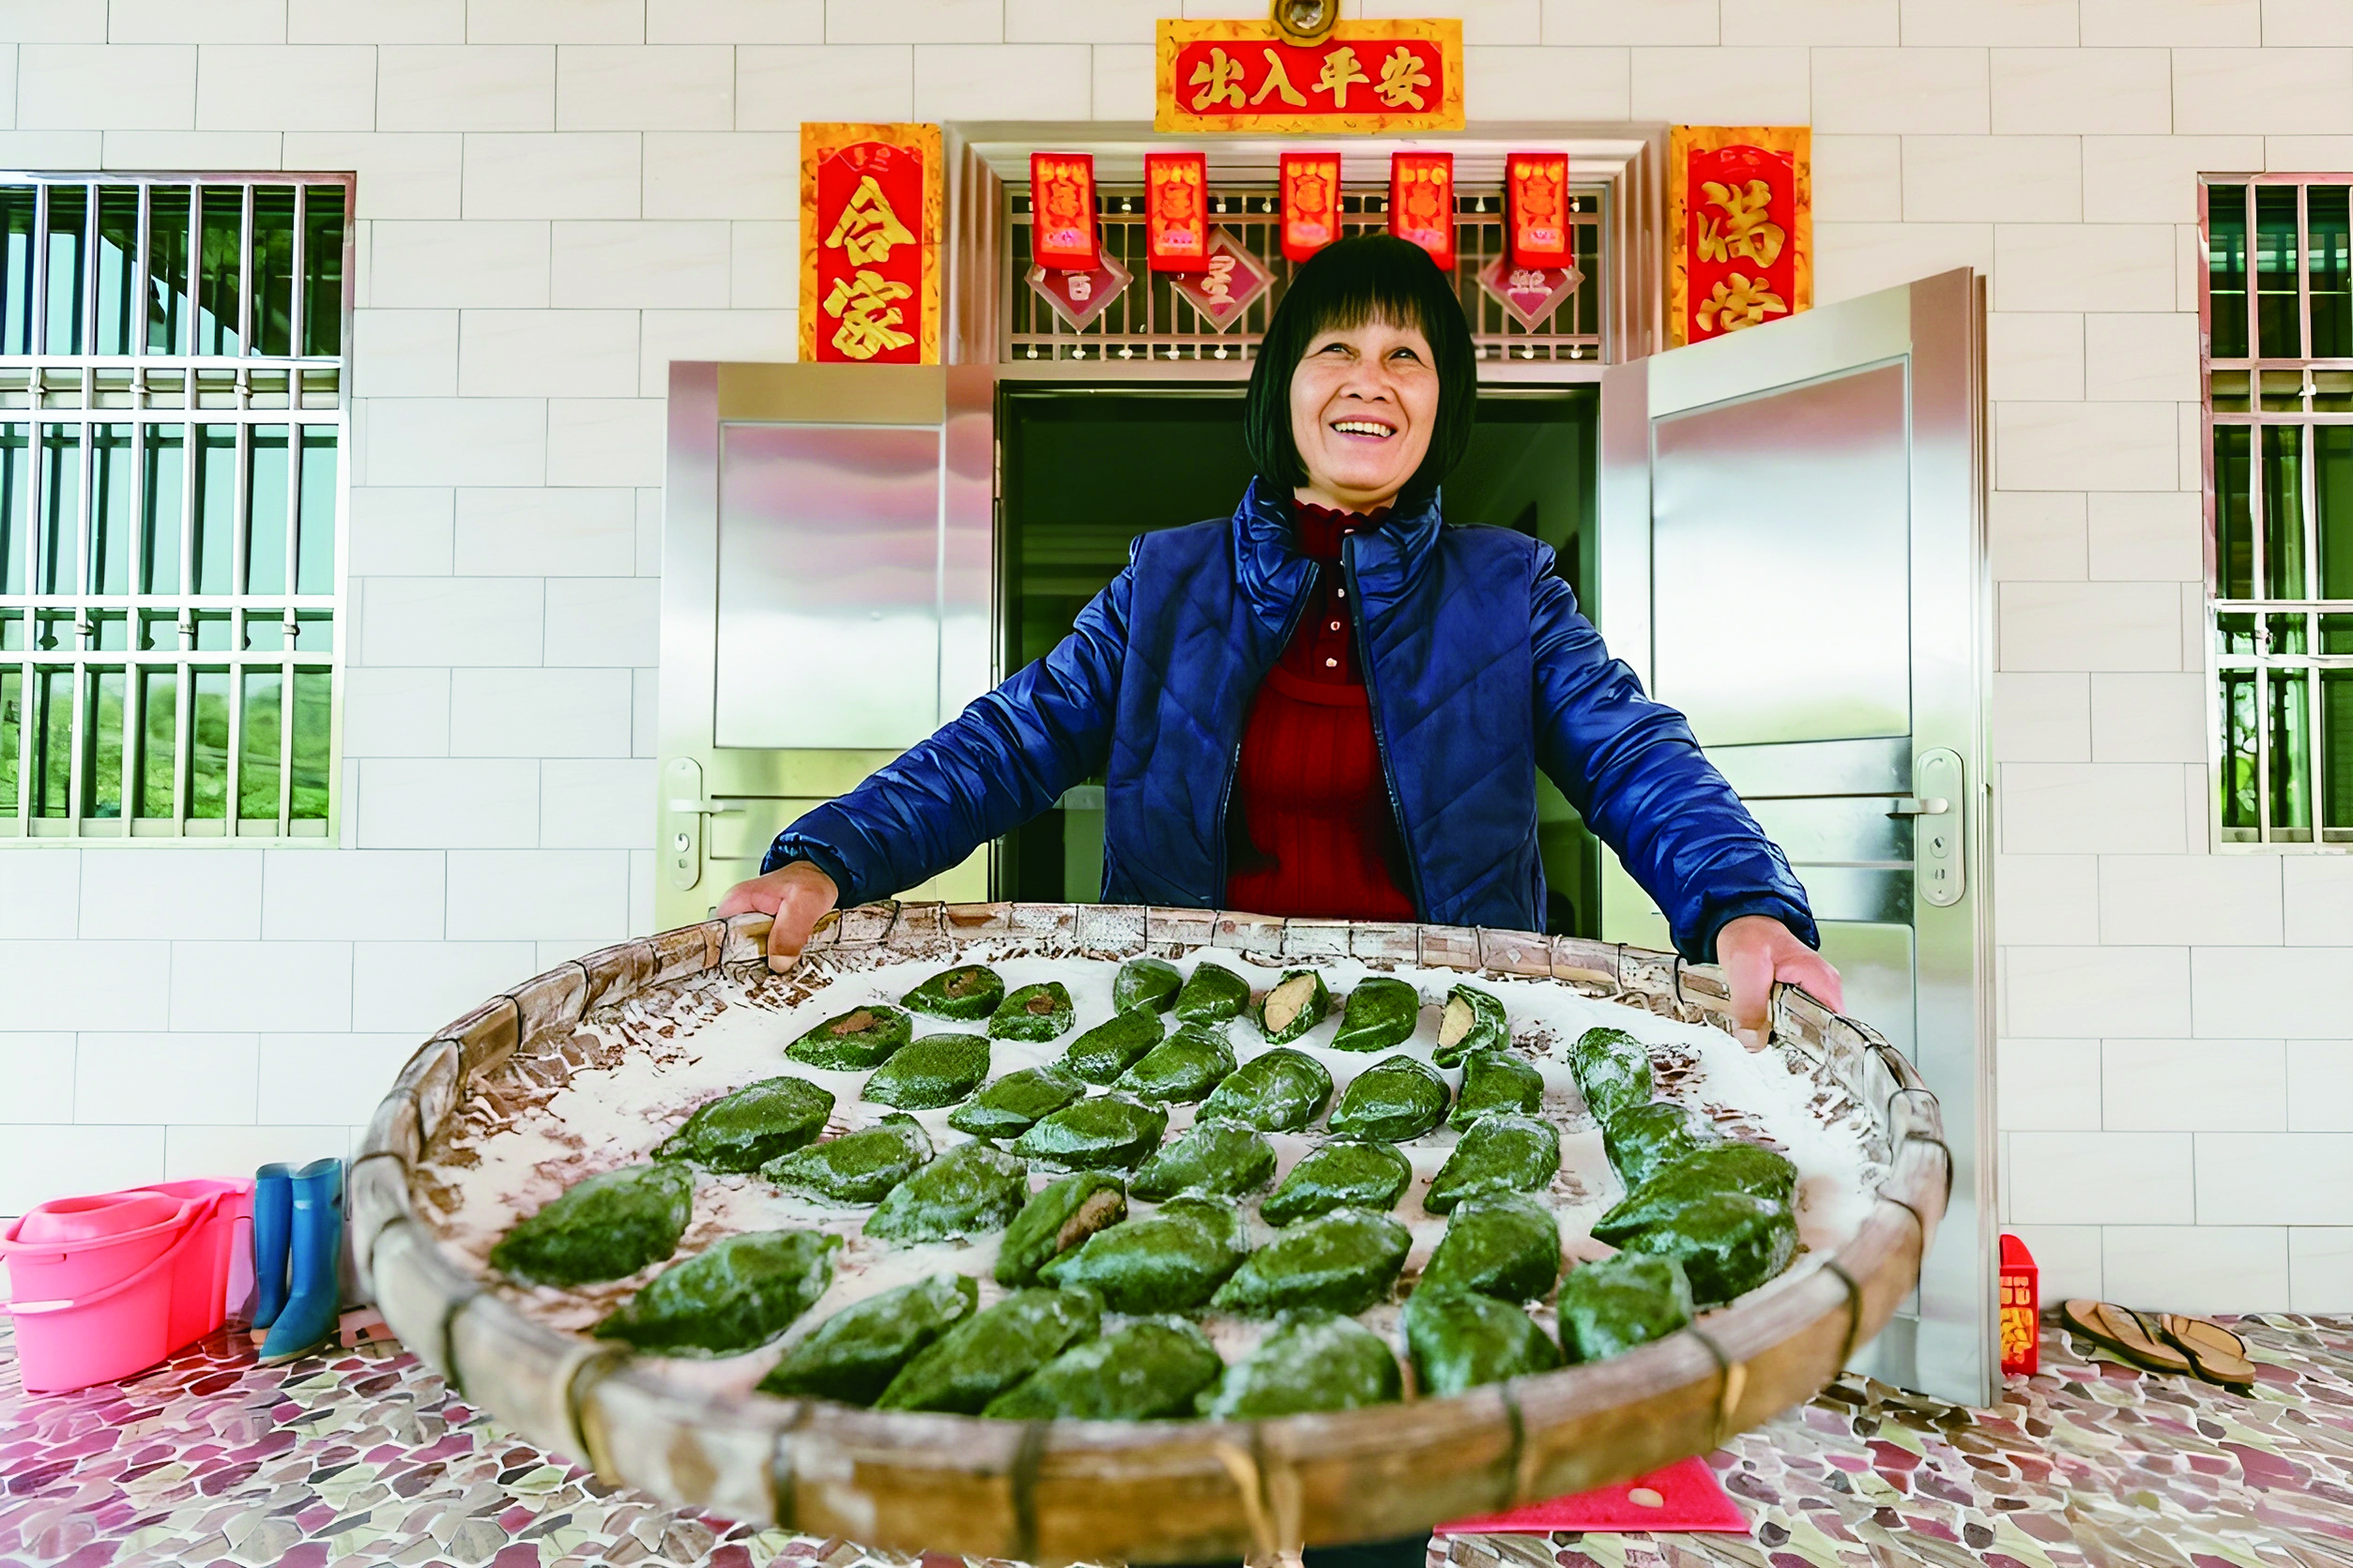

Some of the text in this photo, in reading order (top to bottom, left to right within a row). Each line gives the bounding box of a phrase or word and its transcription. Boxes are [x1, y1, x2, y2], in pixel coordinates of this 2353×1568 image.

[1188, 46, 1431, 111] 出入平安
[822, 175, 917, 359] 合家
